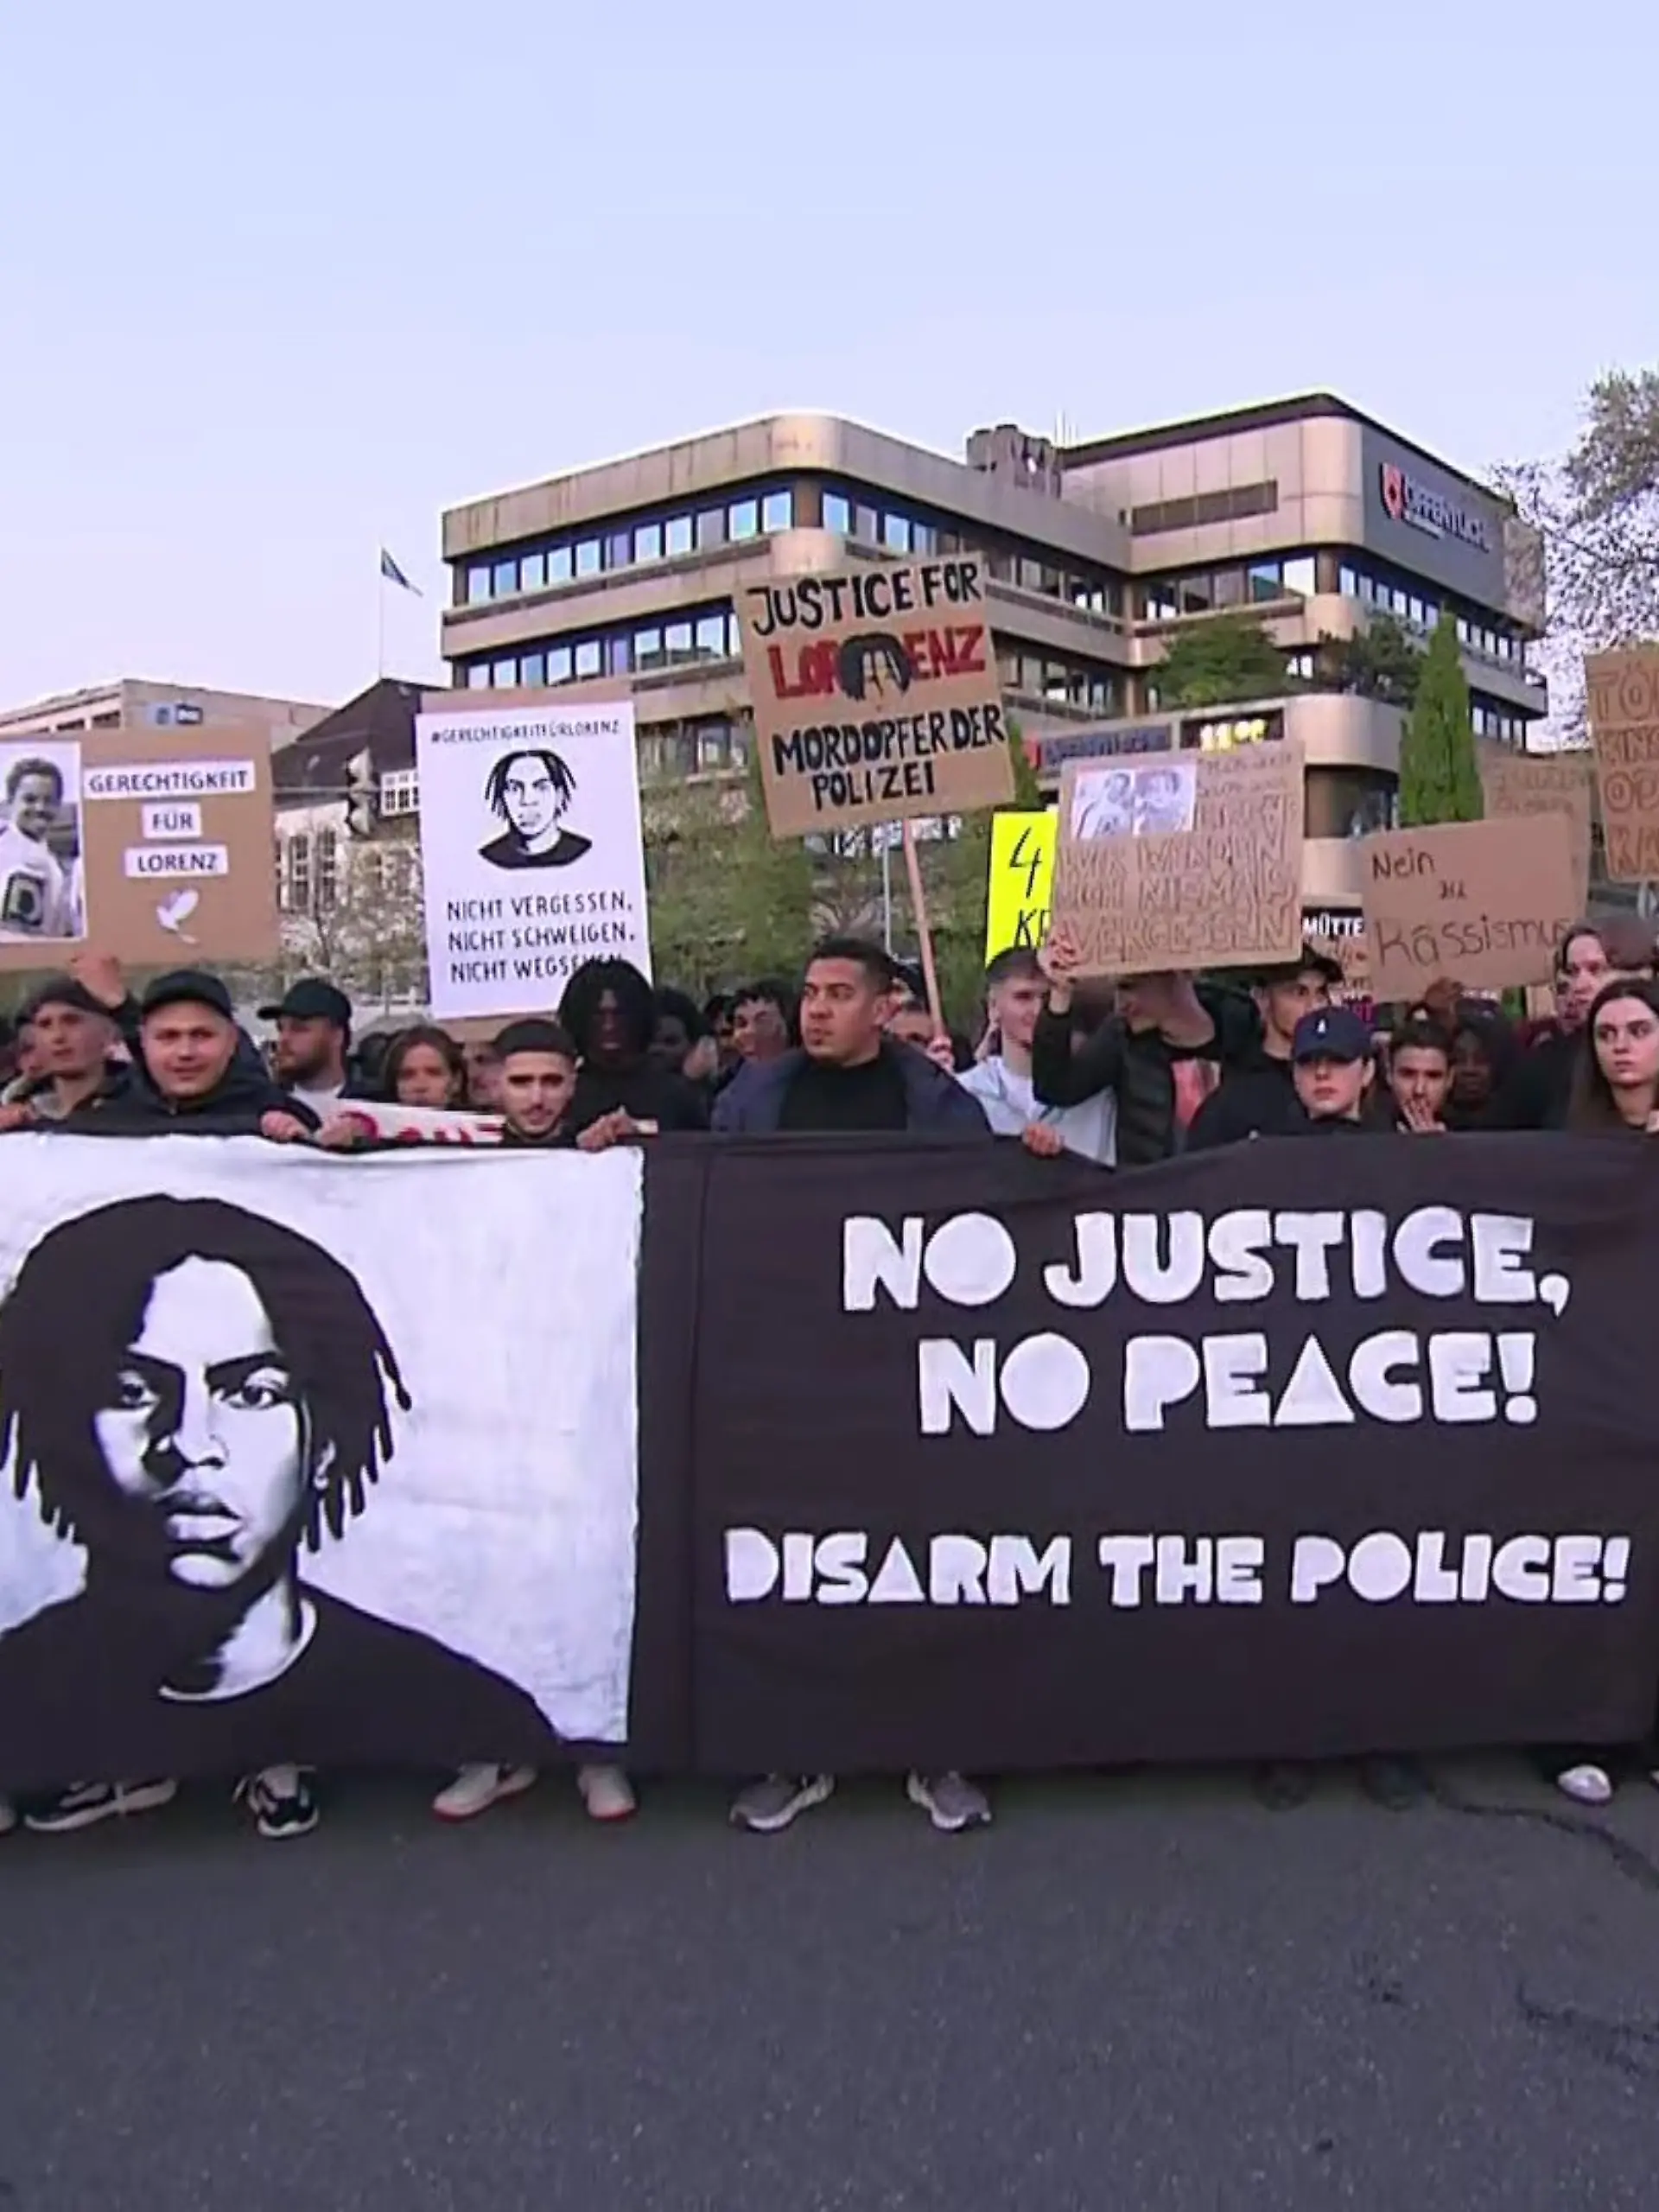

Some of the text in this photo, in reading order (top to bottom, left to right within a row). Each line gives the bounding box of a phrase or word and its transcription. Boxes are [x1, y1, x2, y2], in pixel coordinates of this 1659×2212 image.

[747, 563, 982, 636] JUSTICE FOR
[1590, 660, 1659, 721] TÖ
[772, 711, 948, 777] MORDOPFER
[950, 703, 1006, 750] DER
[88, 770, 248, 792] GERECHTIGKEIT
[812, 760, 935, 811] POLIZEI
[151, 807, 194, 830] FÜR
[137, 852, 219, 873] LORENZ
[1009, 826, 1043, 899] 4
[1372, 847, 1435, 880] Nein
[447, 890, 633, 921] NICHT VERGESSEN.
[448, 921, 636, 951] NICHT SCHWEIGEN.
[450, 959, 506, 983] NICHT
[843, 1206, 1570, 1317] NO JUSTICE,
[918, 1330, 1537, 1434] NO PEACE!
[726, 1528, 1630, 1606] DISARM THE POLICE!
